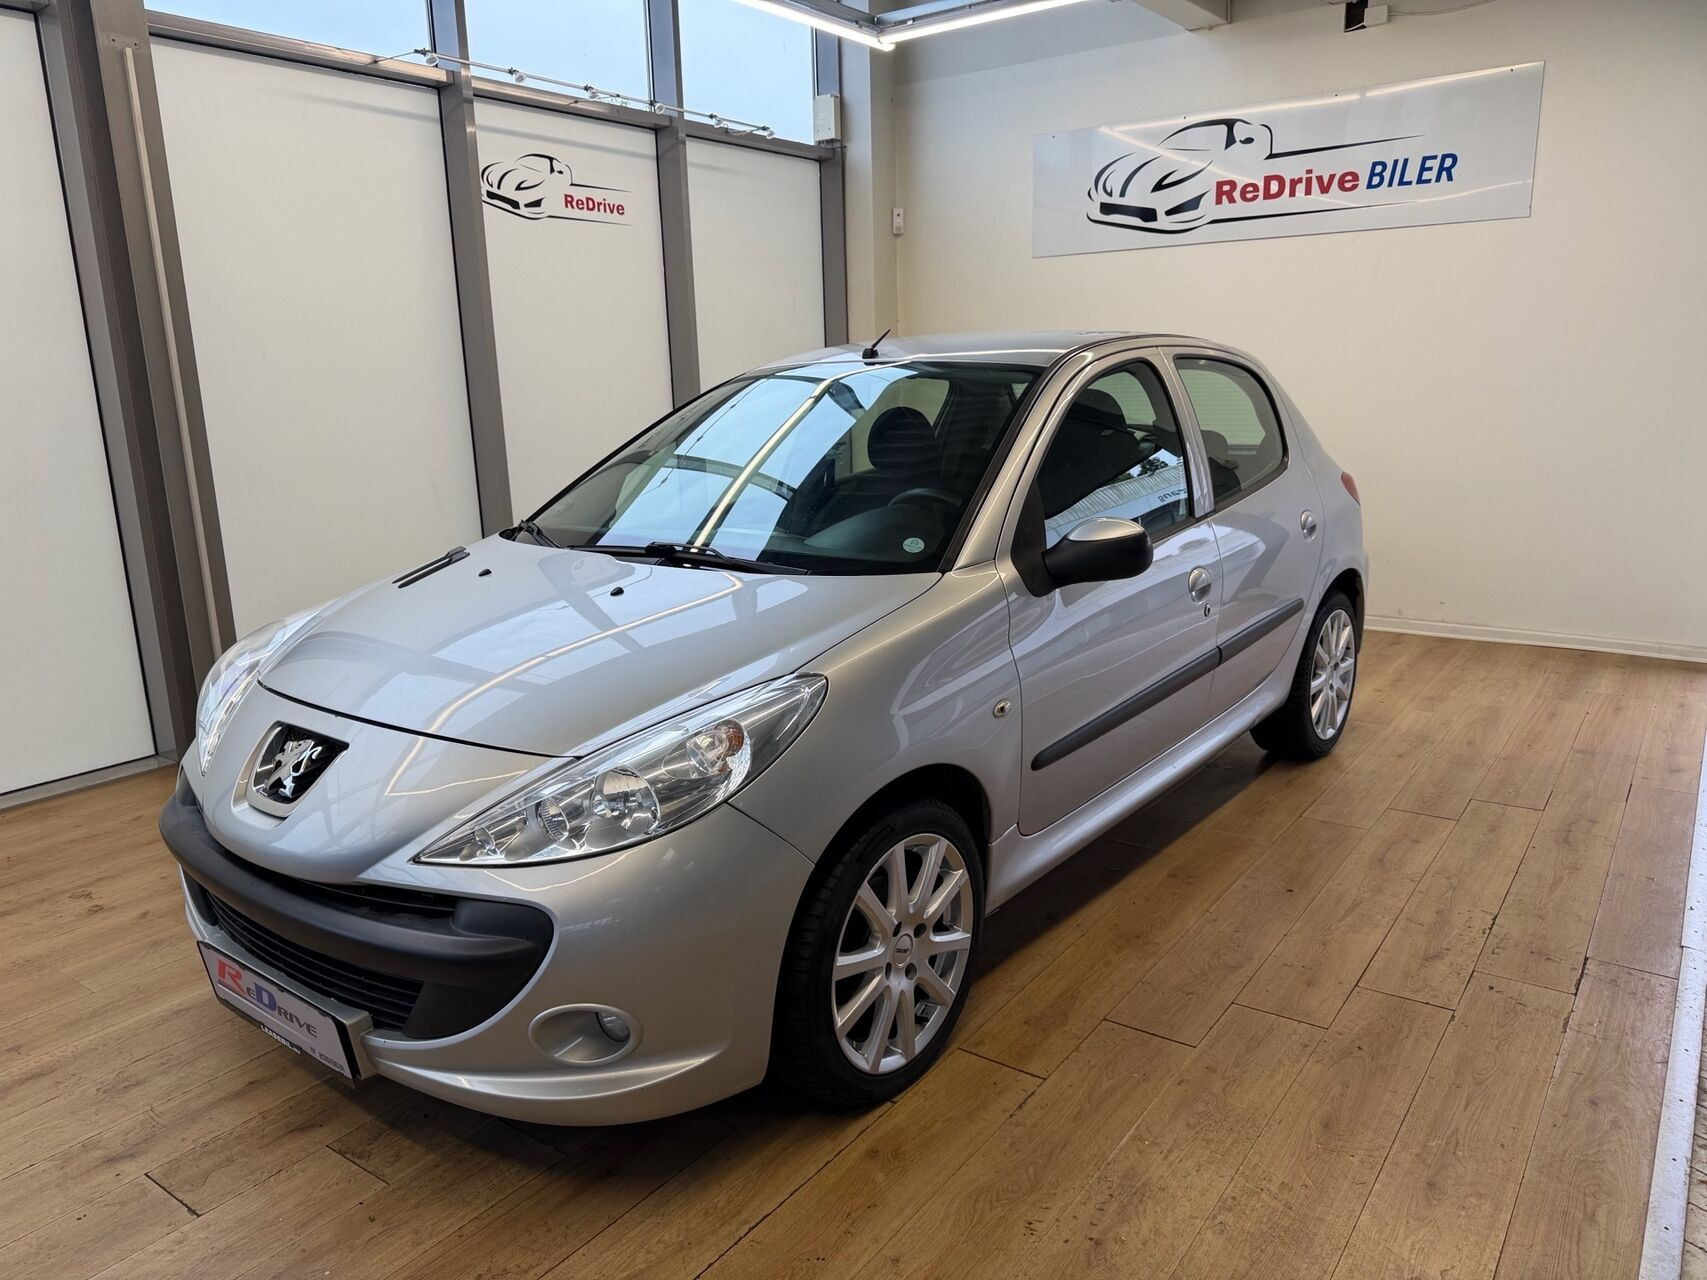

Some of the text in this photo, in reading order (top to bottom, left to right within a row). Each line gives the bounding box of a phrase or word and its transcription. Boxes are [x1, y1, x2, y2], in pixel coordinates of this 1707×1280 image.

[1215, 153, 1457, 206] ReDrive BILER
[564, 193, 625, 215] ReDrive
